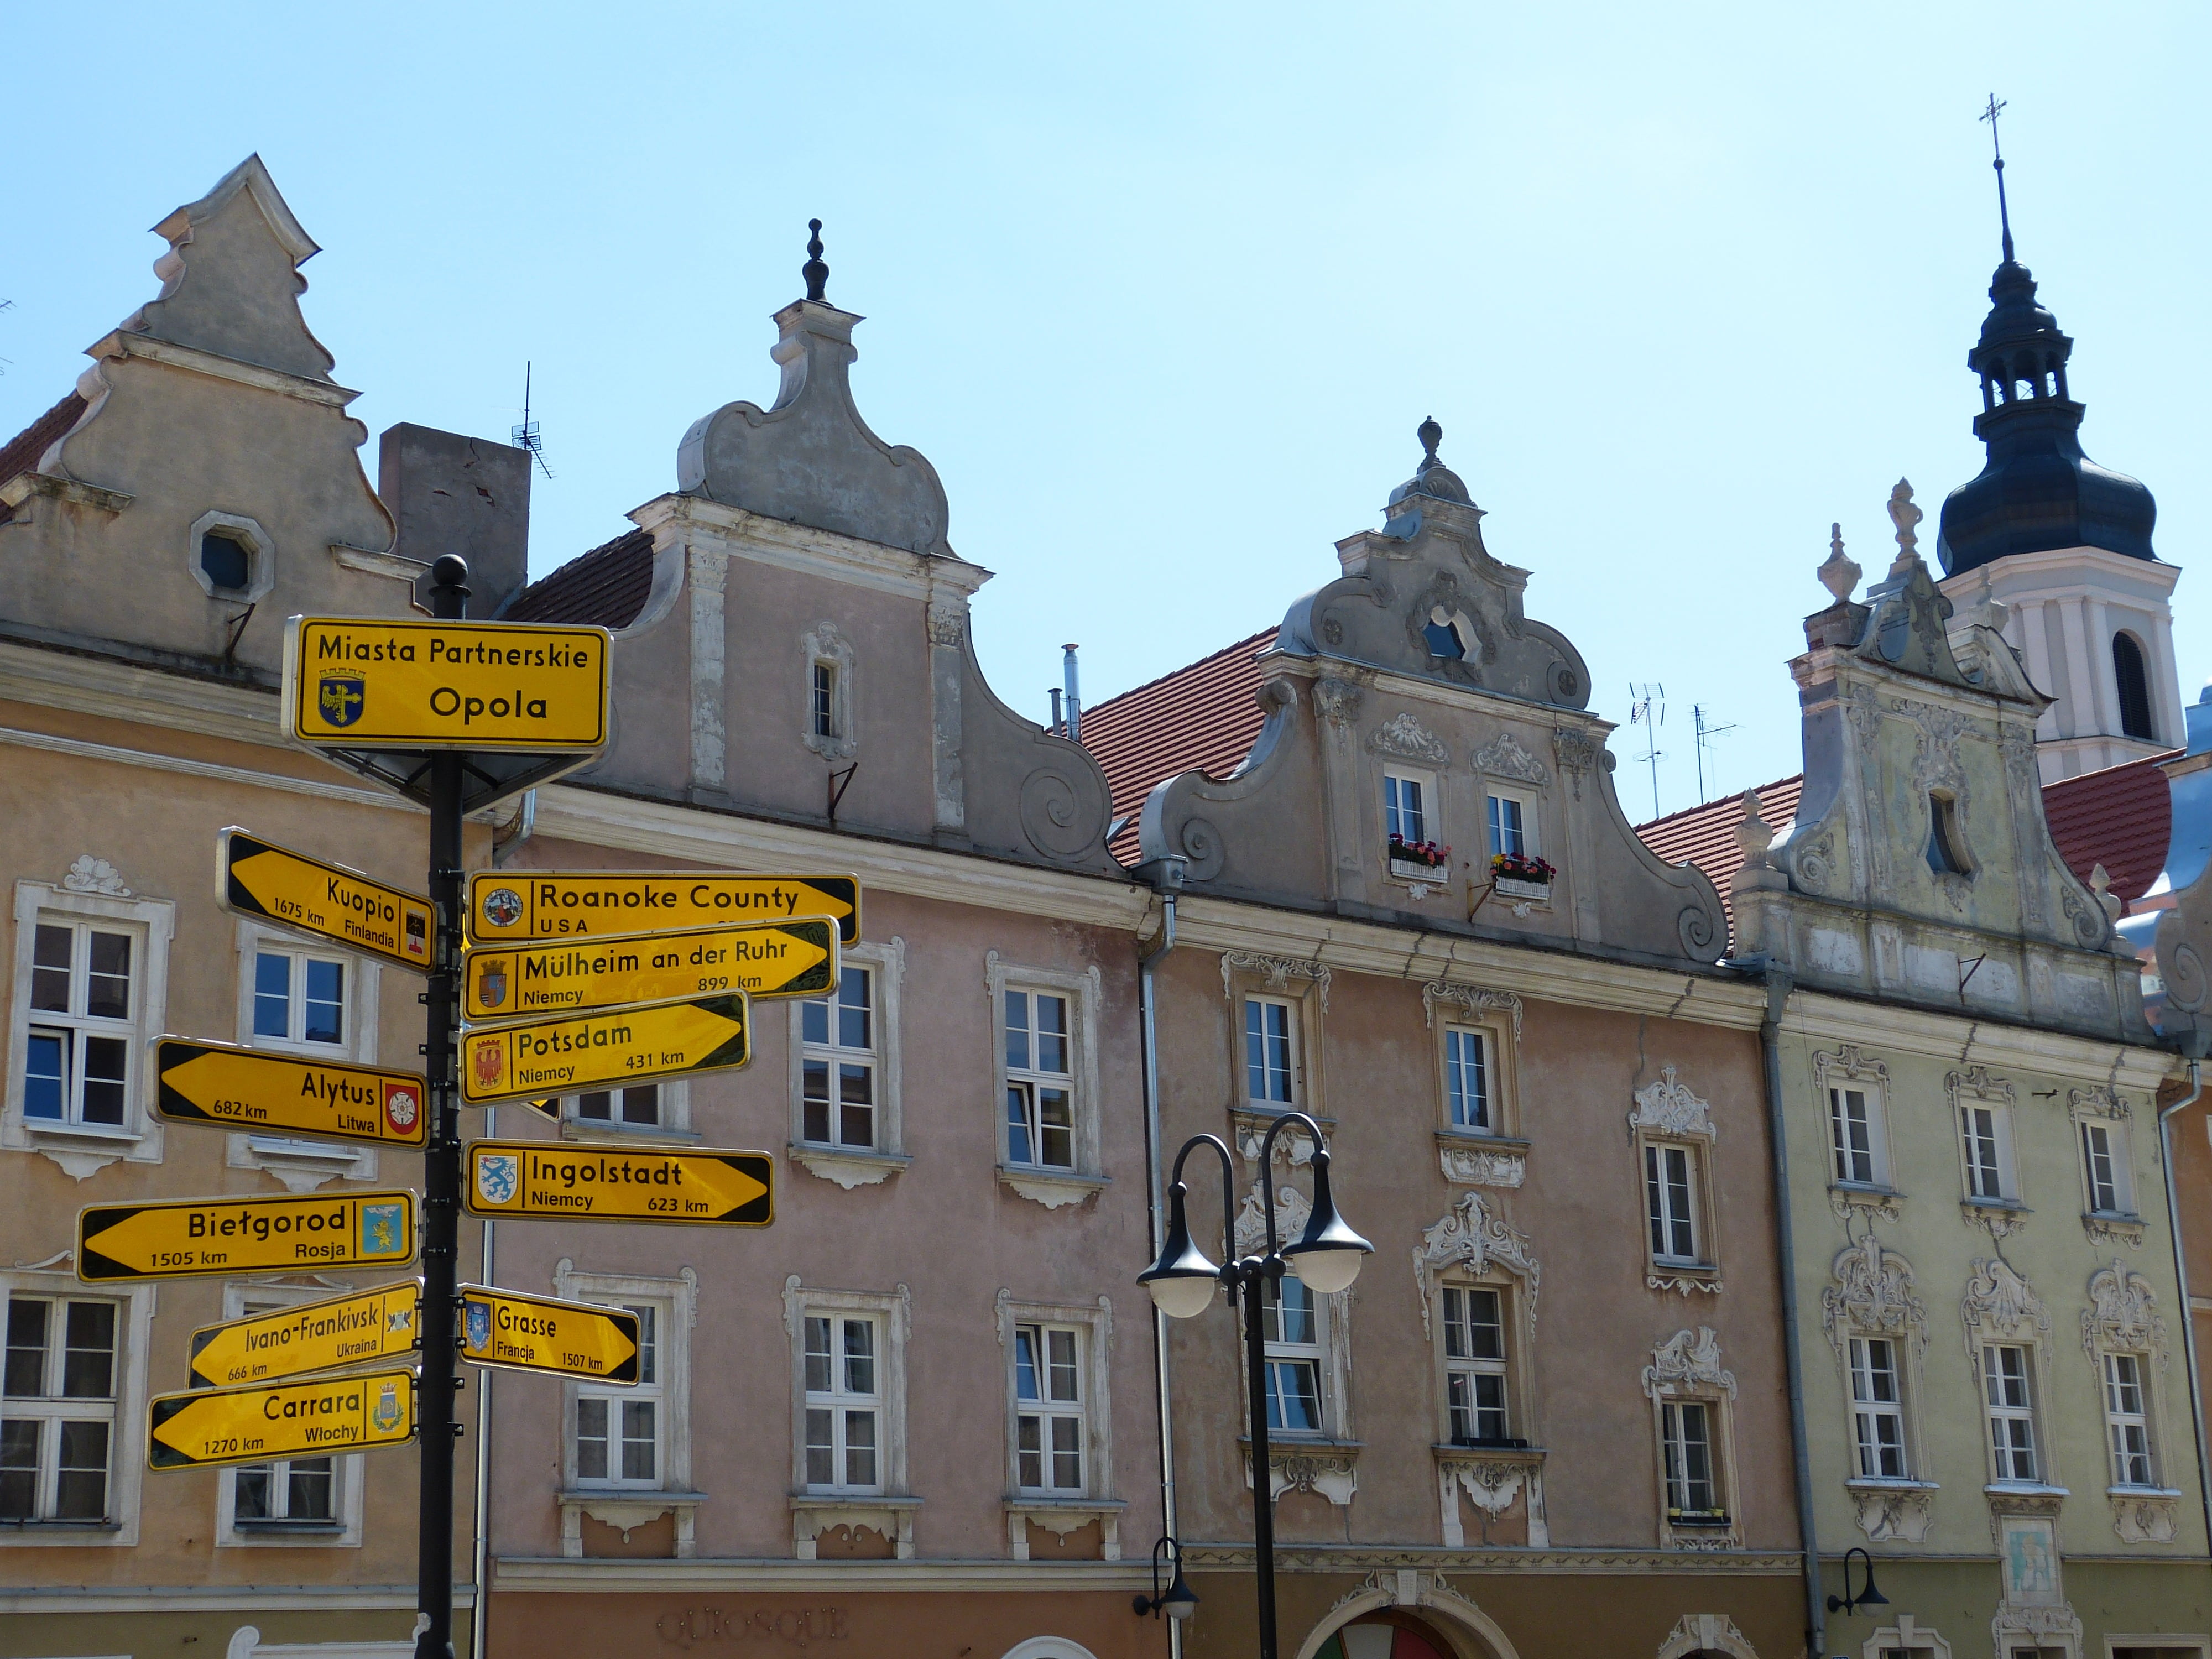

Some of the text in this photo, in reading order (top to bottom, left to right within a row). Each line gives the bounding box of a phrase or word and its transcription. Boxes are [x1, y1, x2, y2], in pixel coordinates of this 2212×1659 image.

[318, 634, 588, 668] Miasta Partnerskie
[429, 687, 547, 726] Opola
[327, 877, 394, 922] Kuopio
[540, 884, 677, 907] Roanoke
[690, 884, 799, 915] County
[274, 898, 324, 926] 1675 km
[345, 919, 394, 949] Finlandia
[541, 919, 588, 932] USA
[525, 938, 787, 980] Mülheim an der Ruhr
[698, 975, 761, 991] 899 km
[524, 990, 583, 1005] Niemcy
[519, 1024, 632, 1058] Potsdam
[625, 1052, 684, 1070] 431 km
[519, 1066, 575, 1084] Niemcy
[301, 1072, 374, 1108] Alytus
[213, 1100, 267, 1119] 682 km
[338, 1114, 375, 1133] Litwa
[533, 1155, 682, 1188] Ingolstadt
[532, 1191, 593, 1211] Niemcy
[648, 1198, 708, 1212] 623 km
[189, 1206, 345, 1241] Biełgorod
[151, 1251, 227, 1266] 1505 km
[295, 1242, 345, 1260] Rosja
[246, 1302, 378, 1352] Ivano-Frankivsk
[498, 1306, 556, 1337] Grasse
[337, 1339, 377, 1358] Ukraina
[498, 1341, 534, 1362] Francja
[562, 1352, 602, 1370] 1507 km
[228, 1363, 267, 1381] 666 km
[264, 1393, 359, 1421] Carrara
[305, 1424, 359, 1442] Włochy
[205, 1437, 263, 1454] 1270 km
